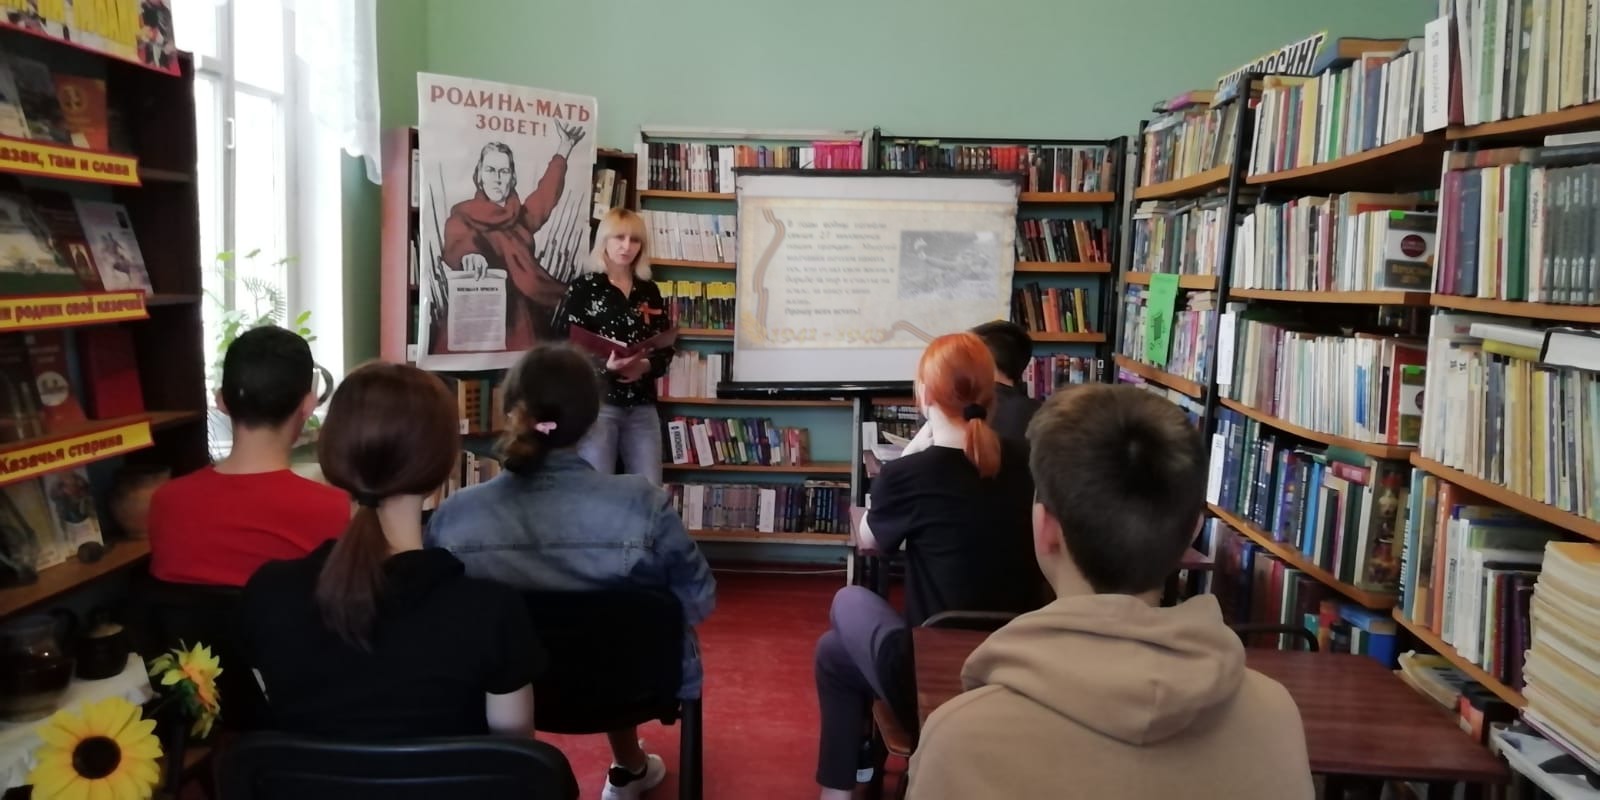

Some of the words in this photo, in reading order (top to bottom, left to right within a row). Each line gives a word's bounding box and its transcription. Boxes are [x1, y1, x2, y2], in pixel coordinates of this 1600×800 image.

[430, 84, 591, 123] РОДИНА-МАТЬ
[475, 113, 548, 138] ЗОВЕТ!
[48, 153, 76, 170] там
[80, 158, 89, 171] и
[92, 160, 130, 177] слава
[15, 303, 63, 324] родник
[66, 296, 94, 316] свой
[0, 449, 65, 475] Казачья
[68, 434, 123, 457] старина
